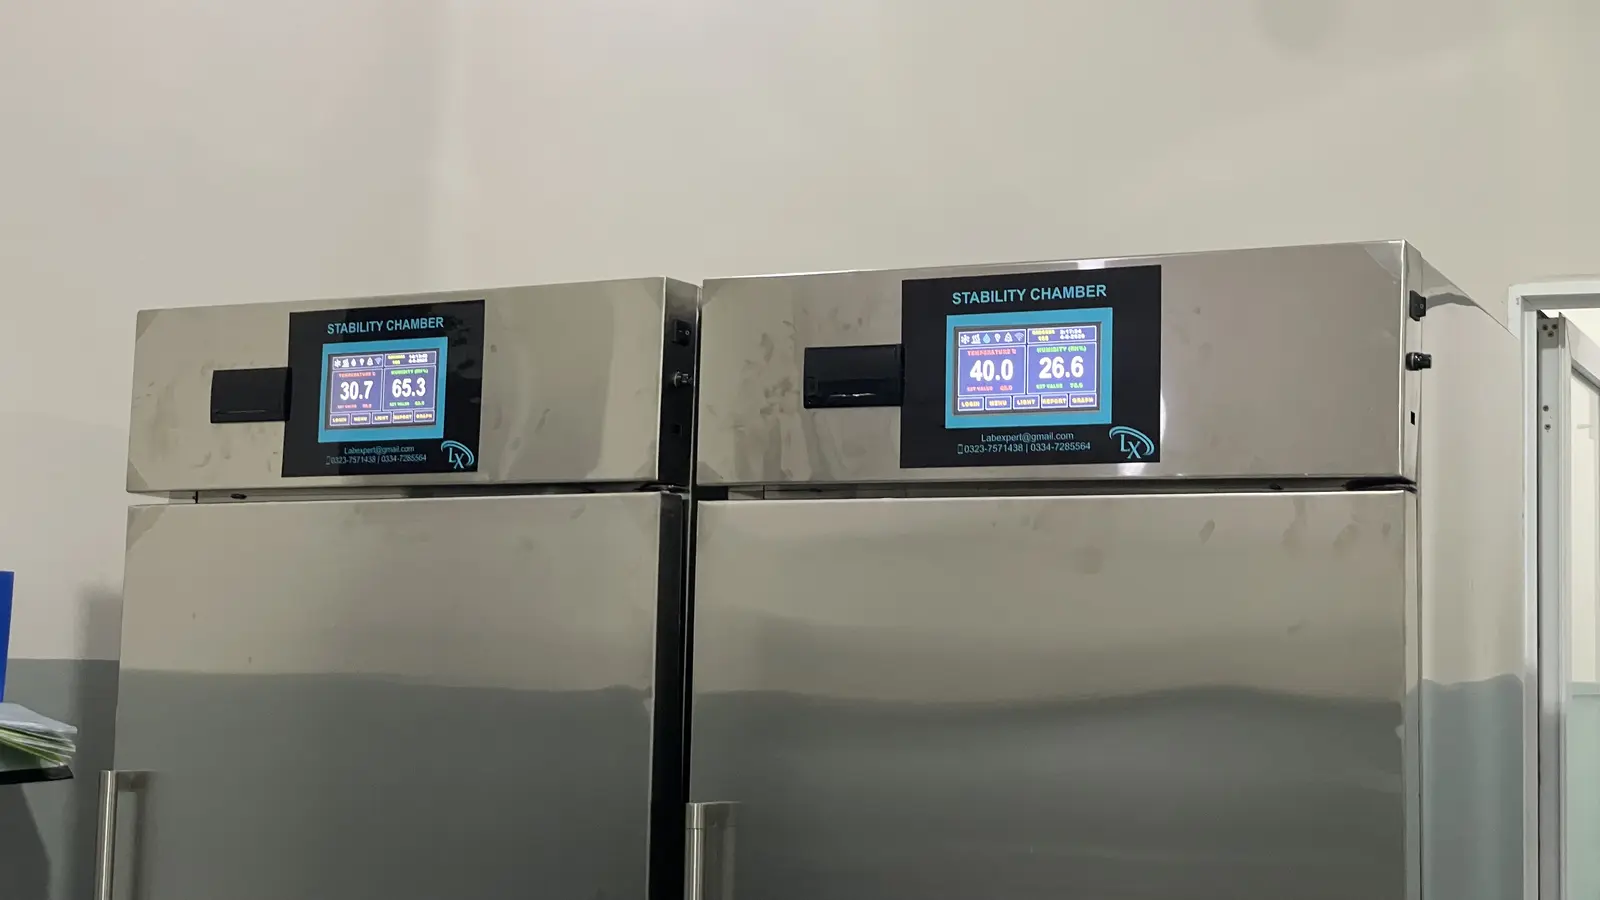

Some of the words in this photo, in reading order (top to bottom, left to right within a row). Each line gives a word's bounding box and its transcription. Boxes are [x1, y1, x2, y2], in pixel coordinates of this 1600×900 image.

[952, 288, 1026, 305] STABILITY
[1030, 284, 1107, 301] CHAMBER
[327, 320, 384, 334] STABILITY
[386, 316, 444, 331] CHAMBER
[970, 359, 1014, 381] 40.0
[1038, 355, 1084, 379] 26.6
[340, 380, 374, 400] 30.7
[391, 377, 426, 398] 65.3
[981, 432, 1074, 443] Labexpert@gmail.com
[344, 445, 415, 455] Labexpert@gmail.com
[964, 443, 1023, 454] 0323-7571438
[1030, 442, 1091, 452] 0334-7285564
[330, 455, 376, 464] 0323-7571438
